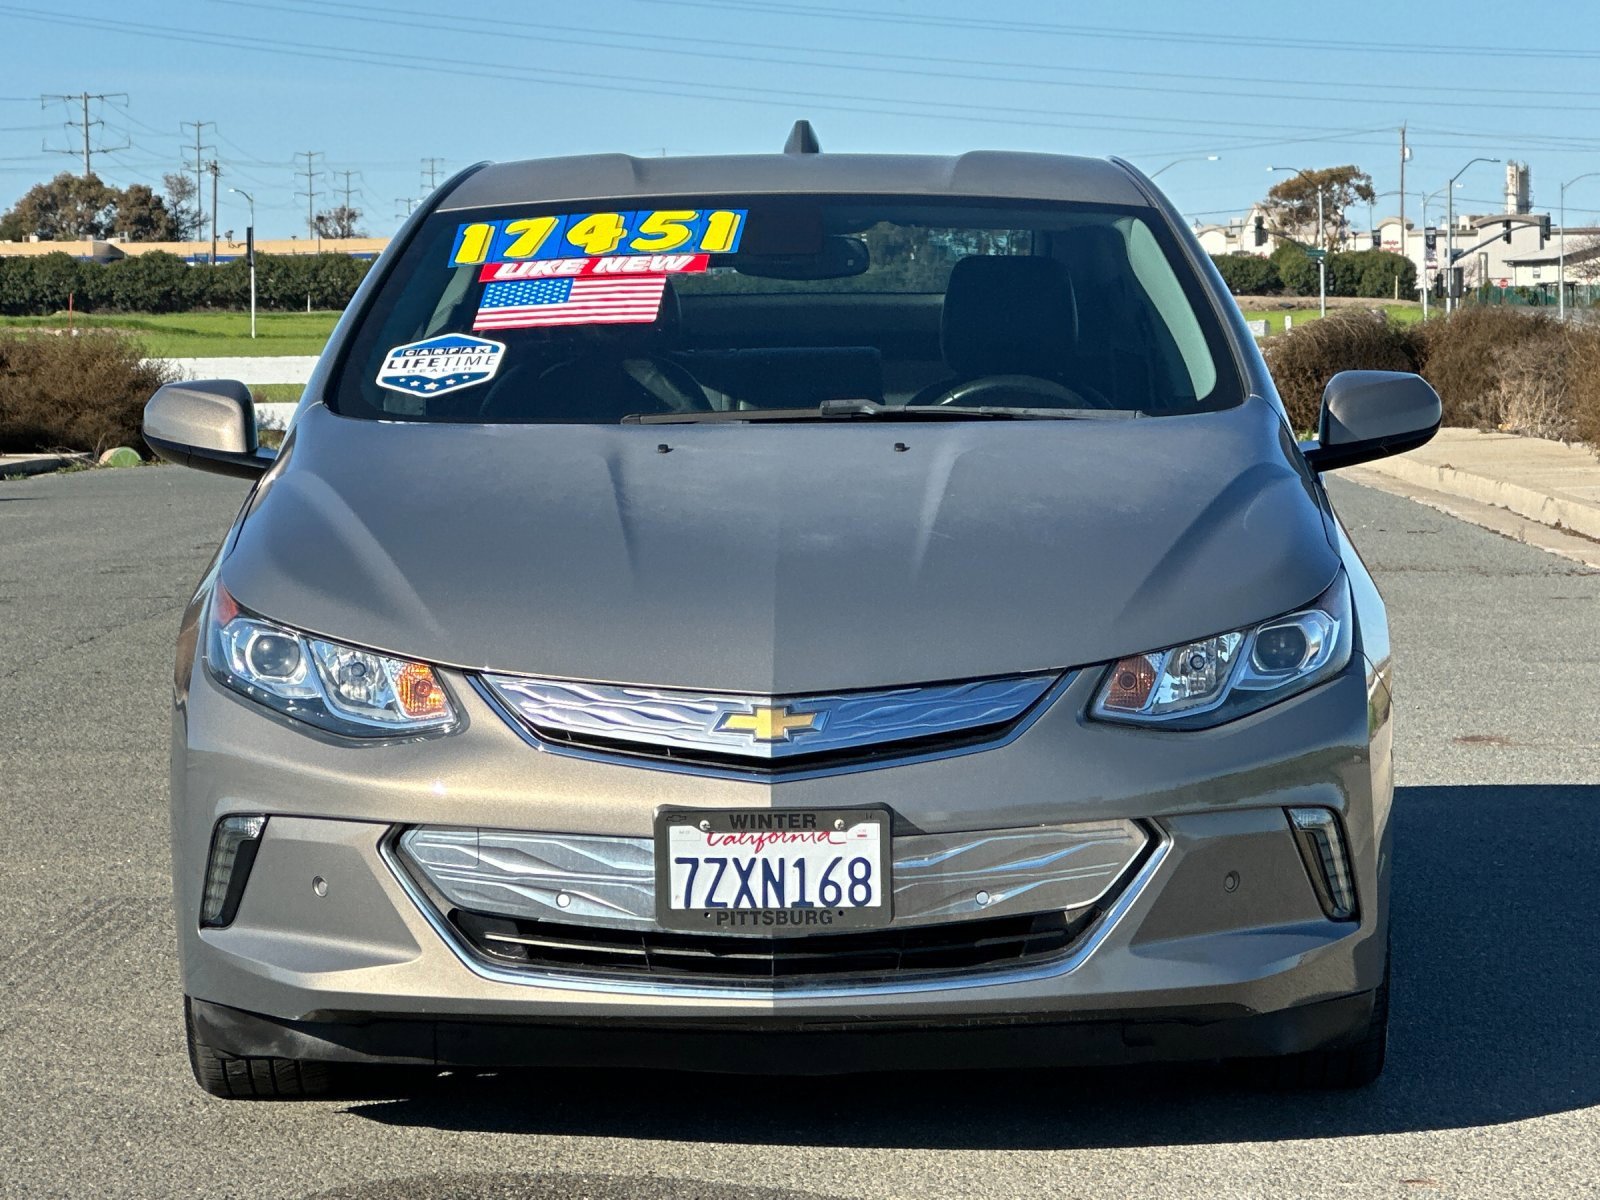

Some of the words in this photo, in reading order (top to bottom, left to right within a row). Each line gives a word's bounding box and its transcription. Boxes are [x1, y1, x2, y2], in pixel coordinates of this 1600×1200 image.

[455, 209, 742, 264] 17451
[493, 257, 589, 279] LIKE
[592, 254, 695, 275] NEW
[402, 346, 492, 357] CARFAX
[387, 355, 497, 370] LIFETIME
[407, 366, 472, 374] DEALER
[729, 813, 817, 829] WINTER
[706, 830, 847, 854] California
[674, 856, 872, 908] 7ZXN168
[716, 909, 833, 926] PITTSBURG
